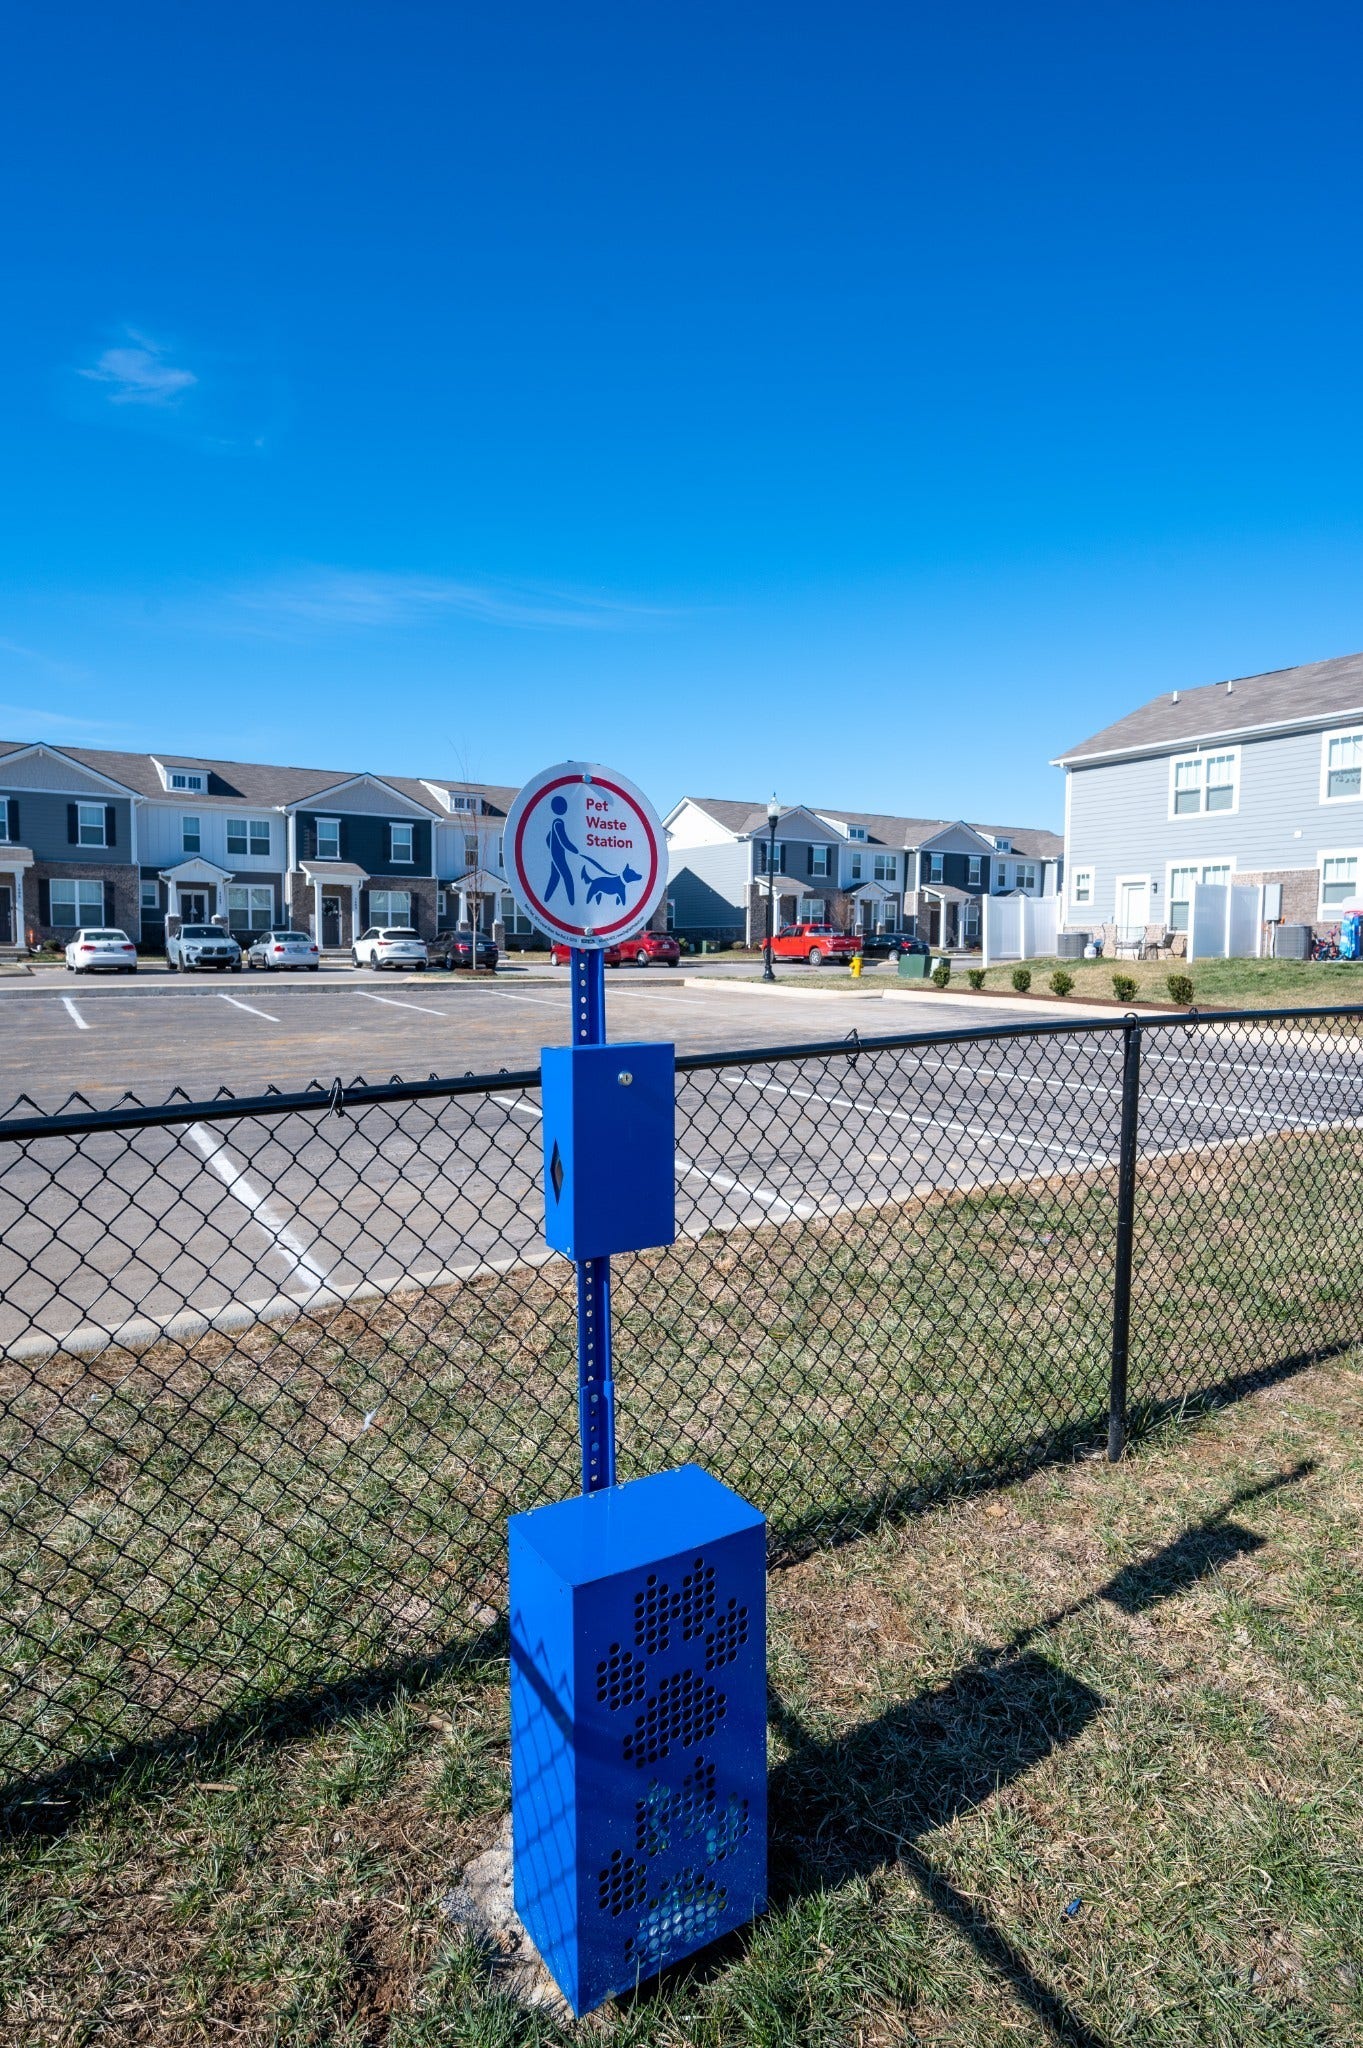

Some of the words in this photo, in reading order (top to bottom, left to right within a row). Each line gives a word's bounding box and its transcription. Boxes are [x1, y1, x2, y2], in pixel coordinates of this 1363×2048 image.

[586, 798, 608, 811] Pet
[586, 816, 627, 830] Waste
[587, 834, 633, 848] Station
